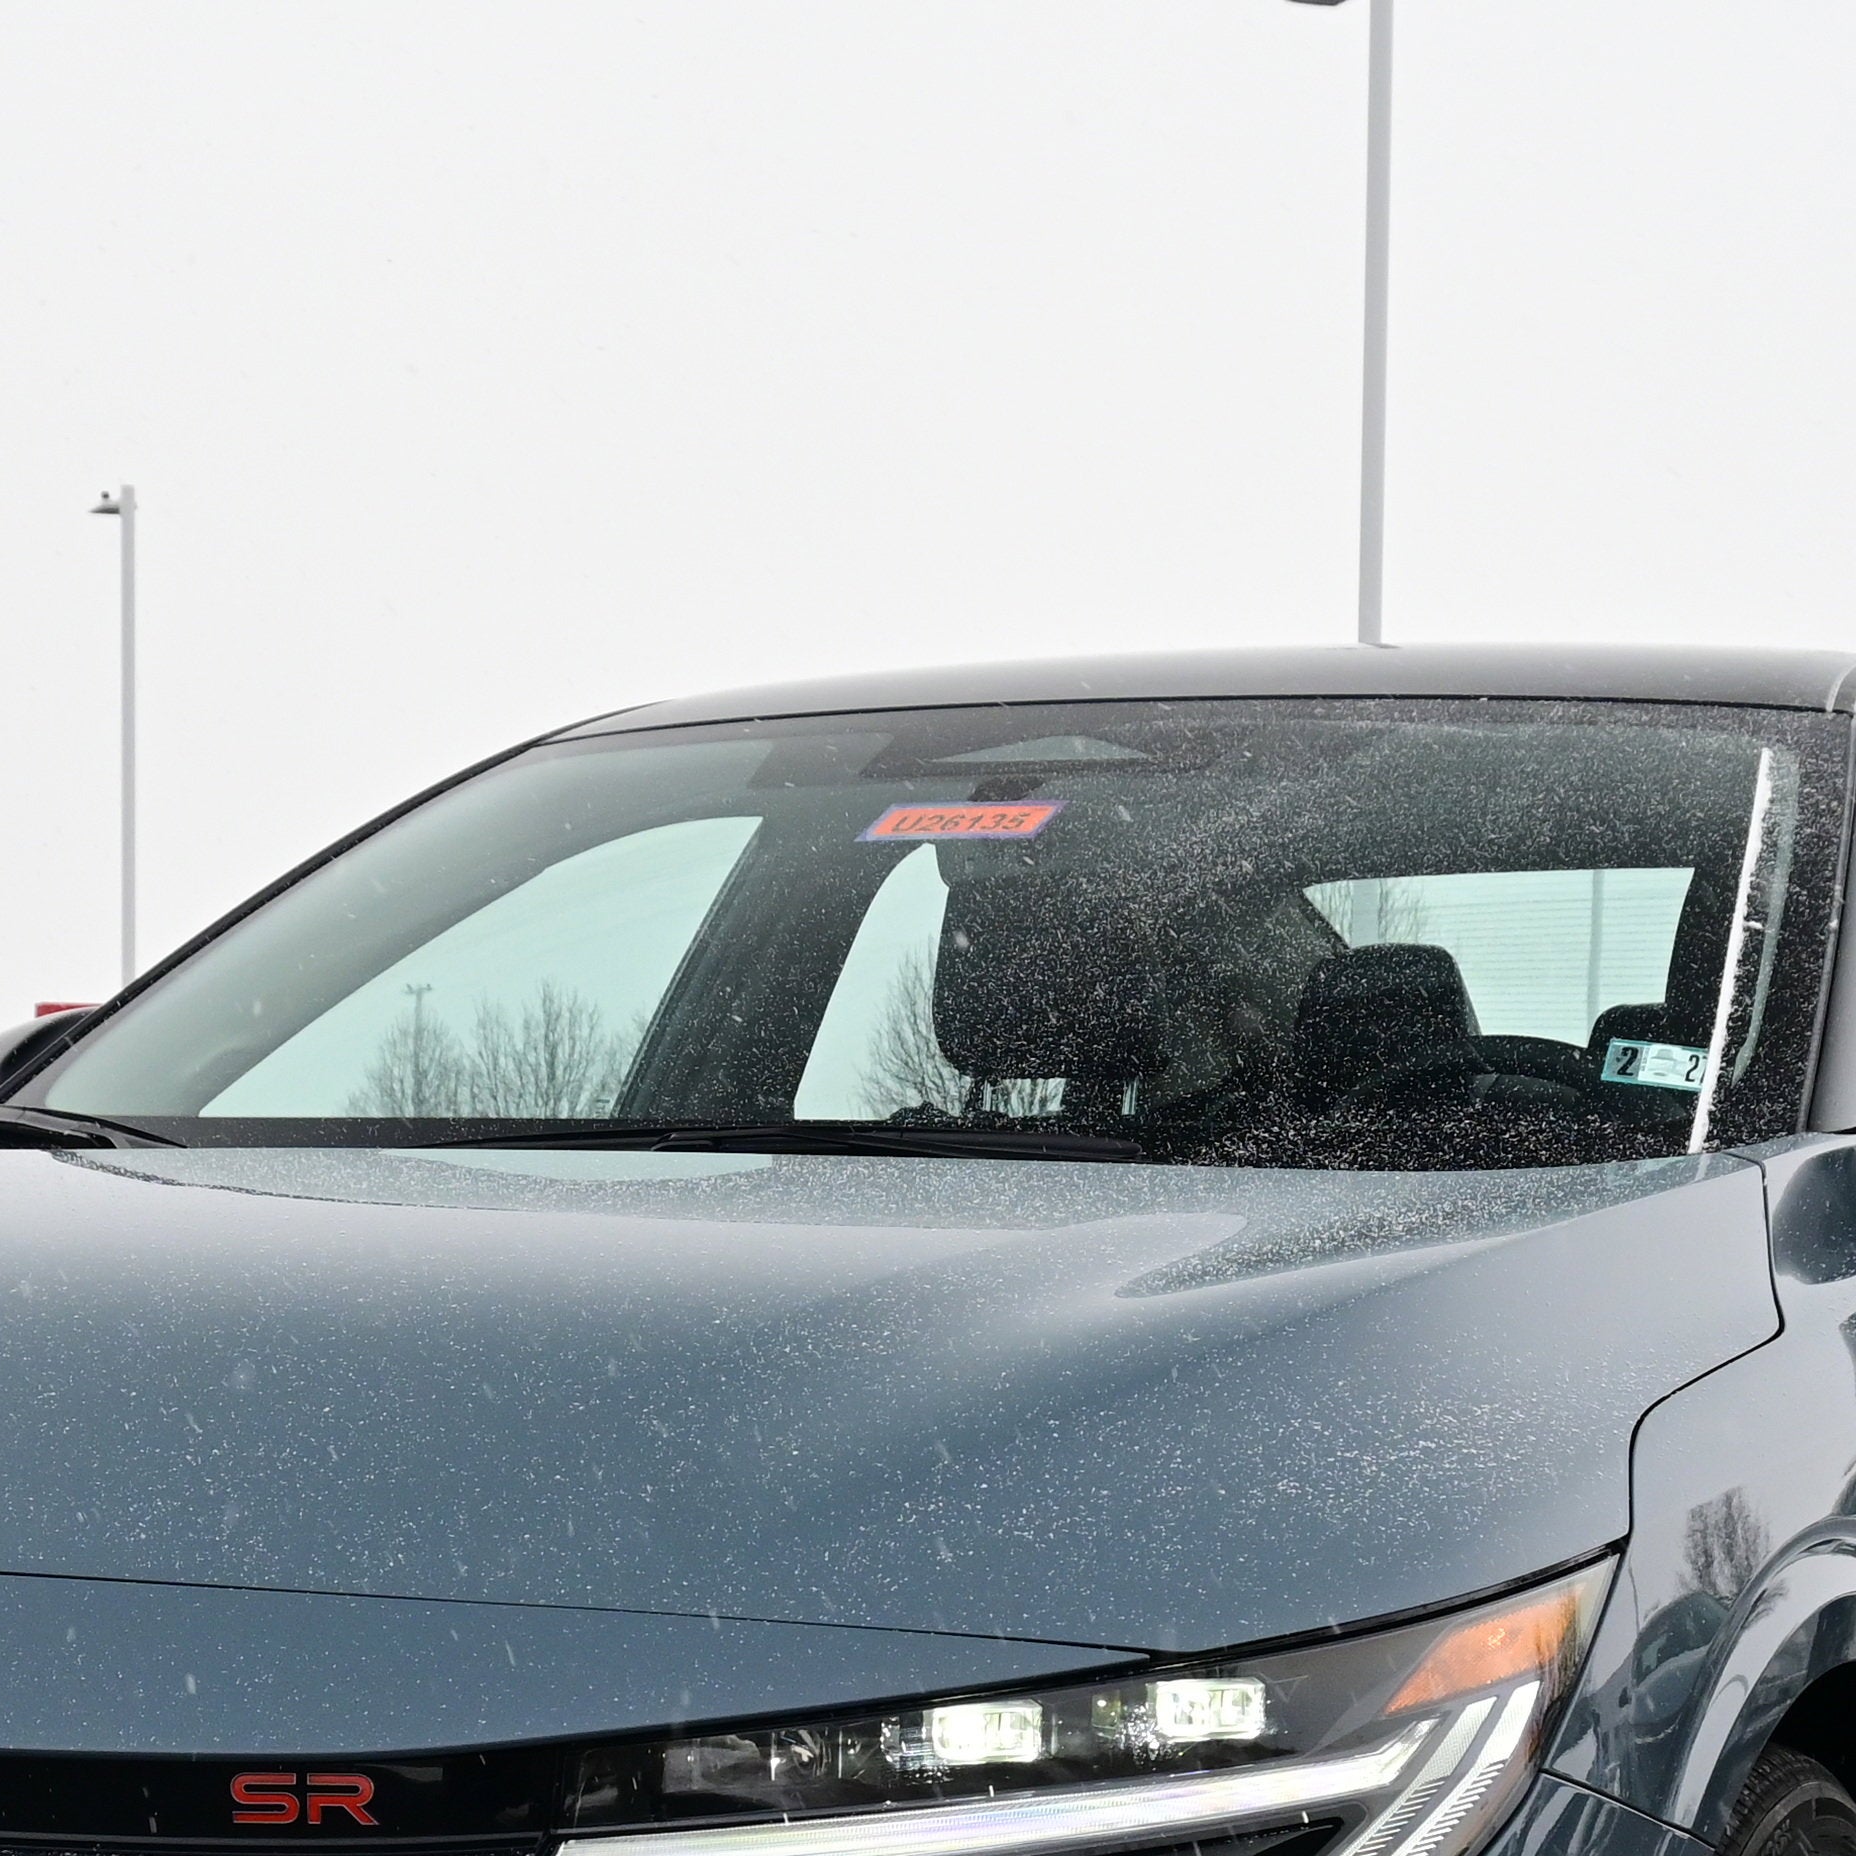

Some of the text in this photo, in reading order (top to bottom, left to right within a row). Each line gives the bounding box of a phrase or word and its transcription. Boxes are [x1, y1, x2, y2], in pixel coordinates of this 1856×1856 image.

[891, 812, 1032, 832] U26135
[1617, 1046, 1640, 1077] 2
[230, 1772, 380, 1826] SR
